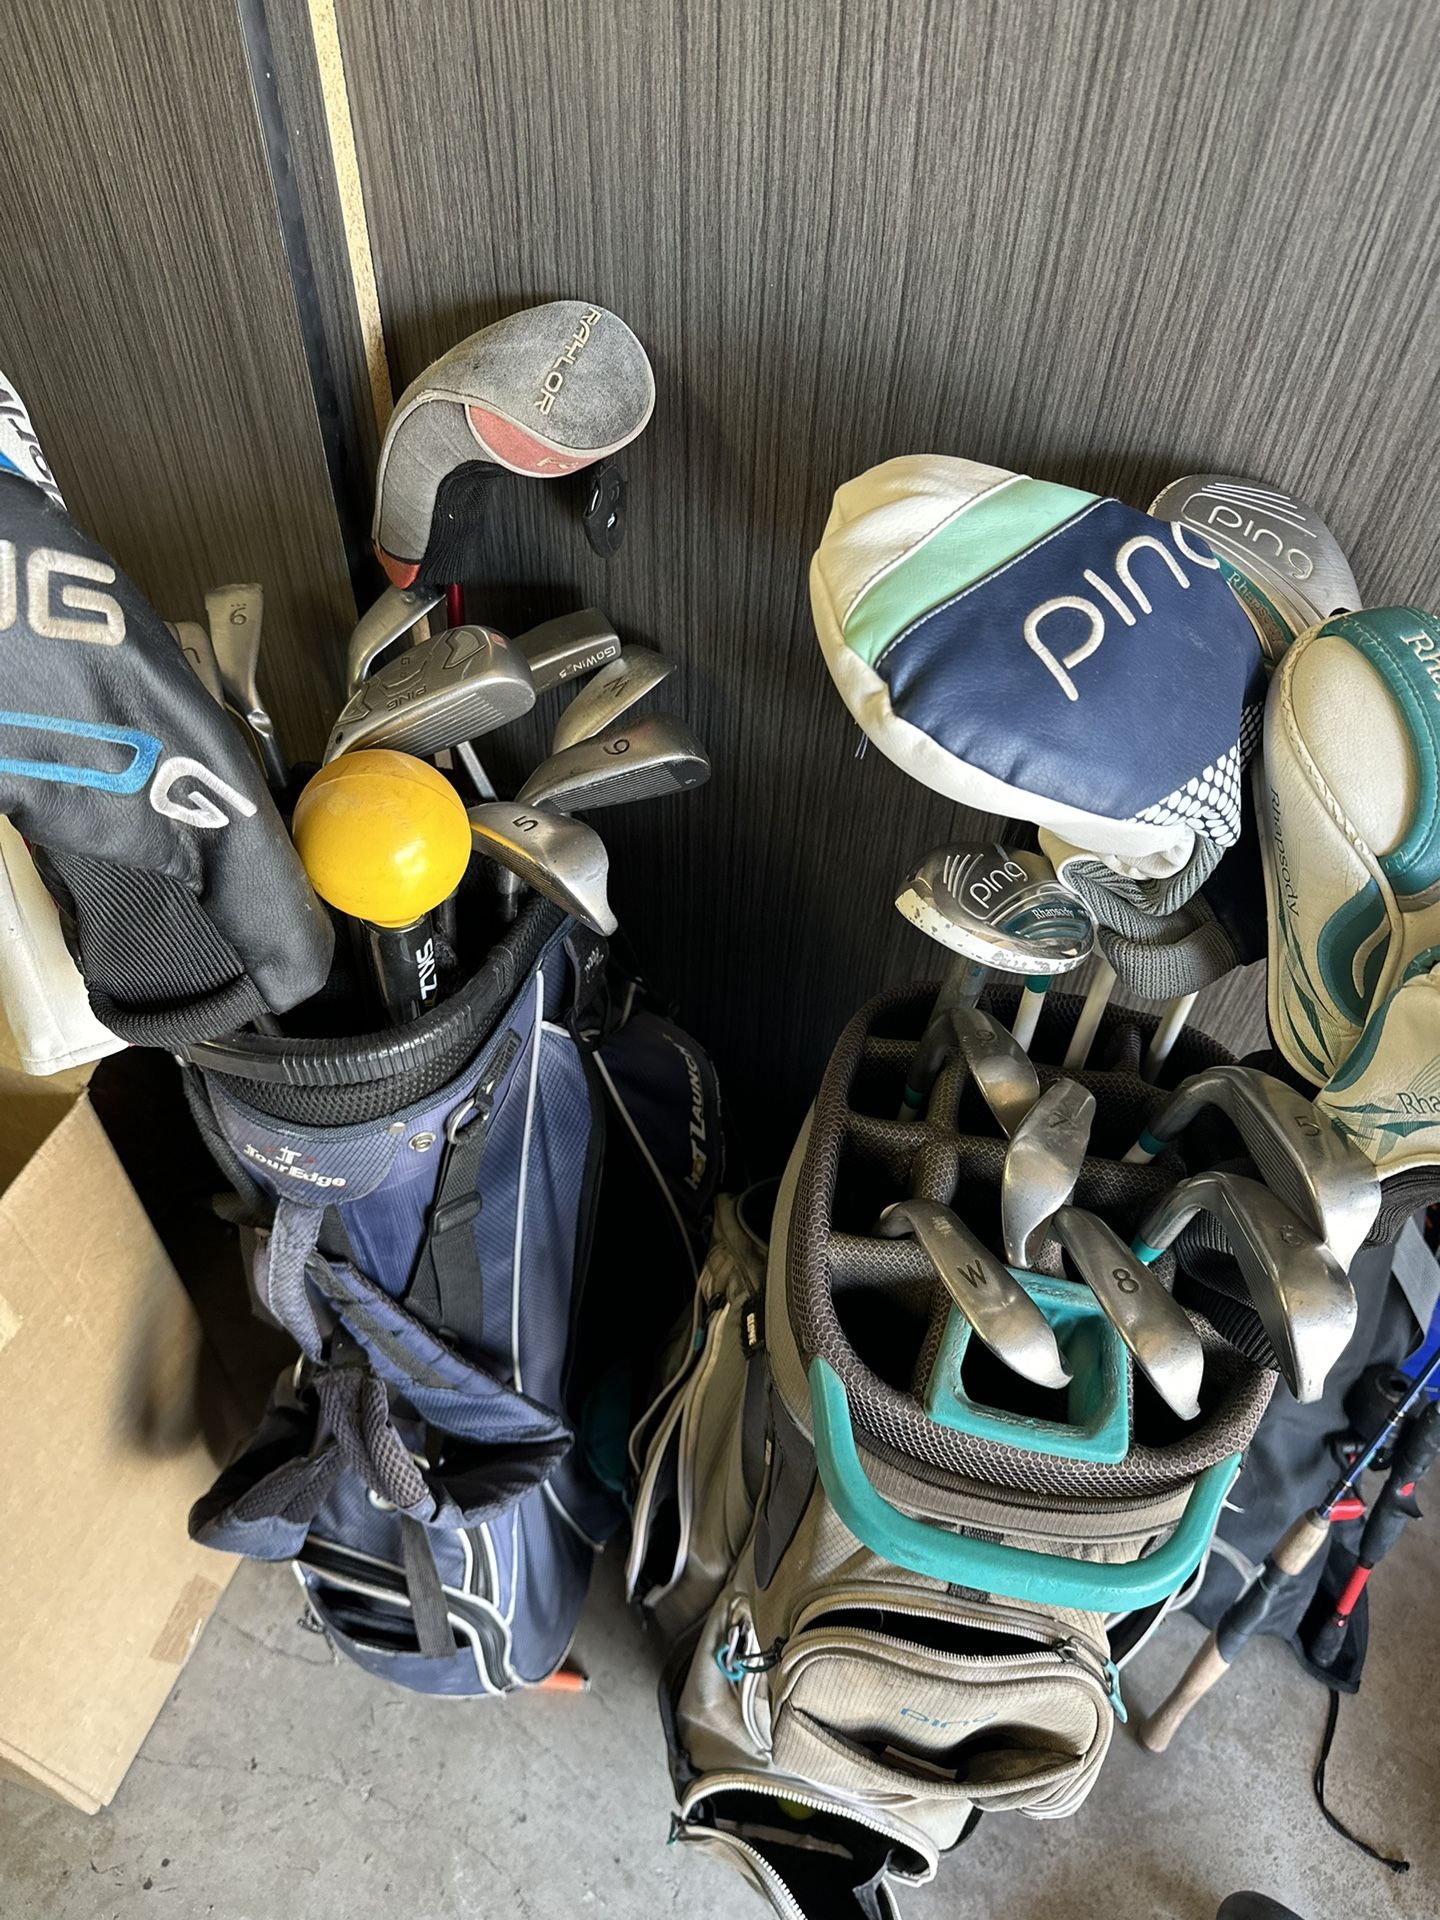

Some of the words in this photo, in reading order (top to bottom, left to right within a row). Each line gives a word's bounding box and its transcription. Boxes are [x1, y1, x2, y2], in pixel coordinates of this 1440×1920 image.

[1208, 505, 1313, 579] ping
[386, 685, 426, 712] PING
[512, 815, 538, 832] 5
[1270, 785, 1299, 917] Rhapsody
[969, 861, 1028, 909] ping
[1031, 906, 1074, 920] Rhapsody
[1294, 1115, 1320, 1136] 5
[957, 1259, 987, 1289] W
[1112, 1268, 1140, 1294] 8
